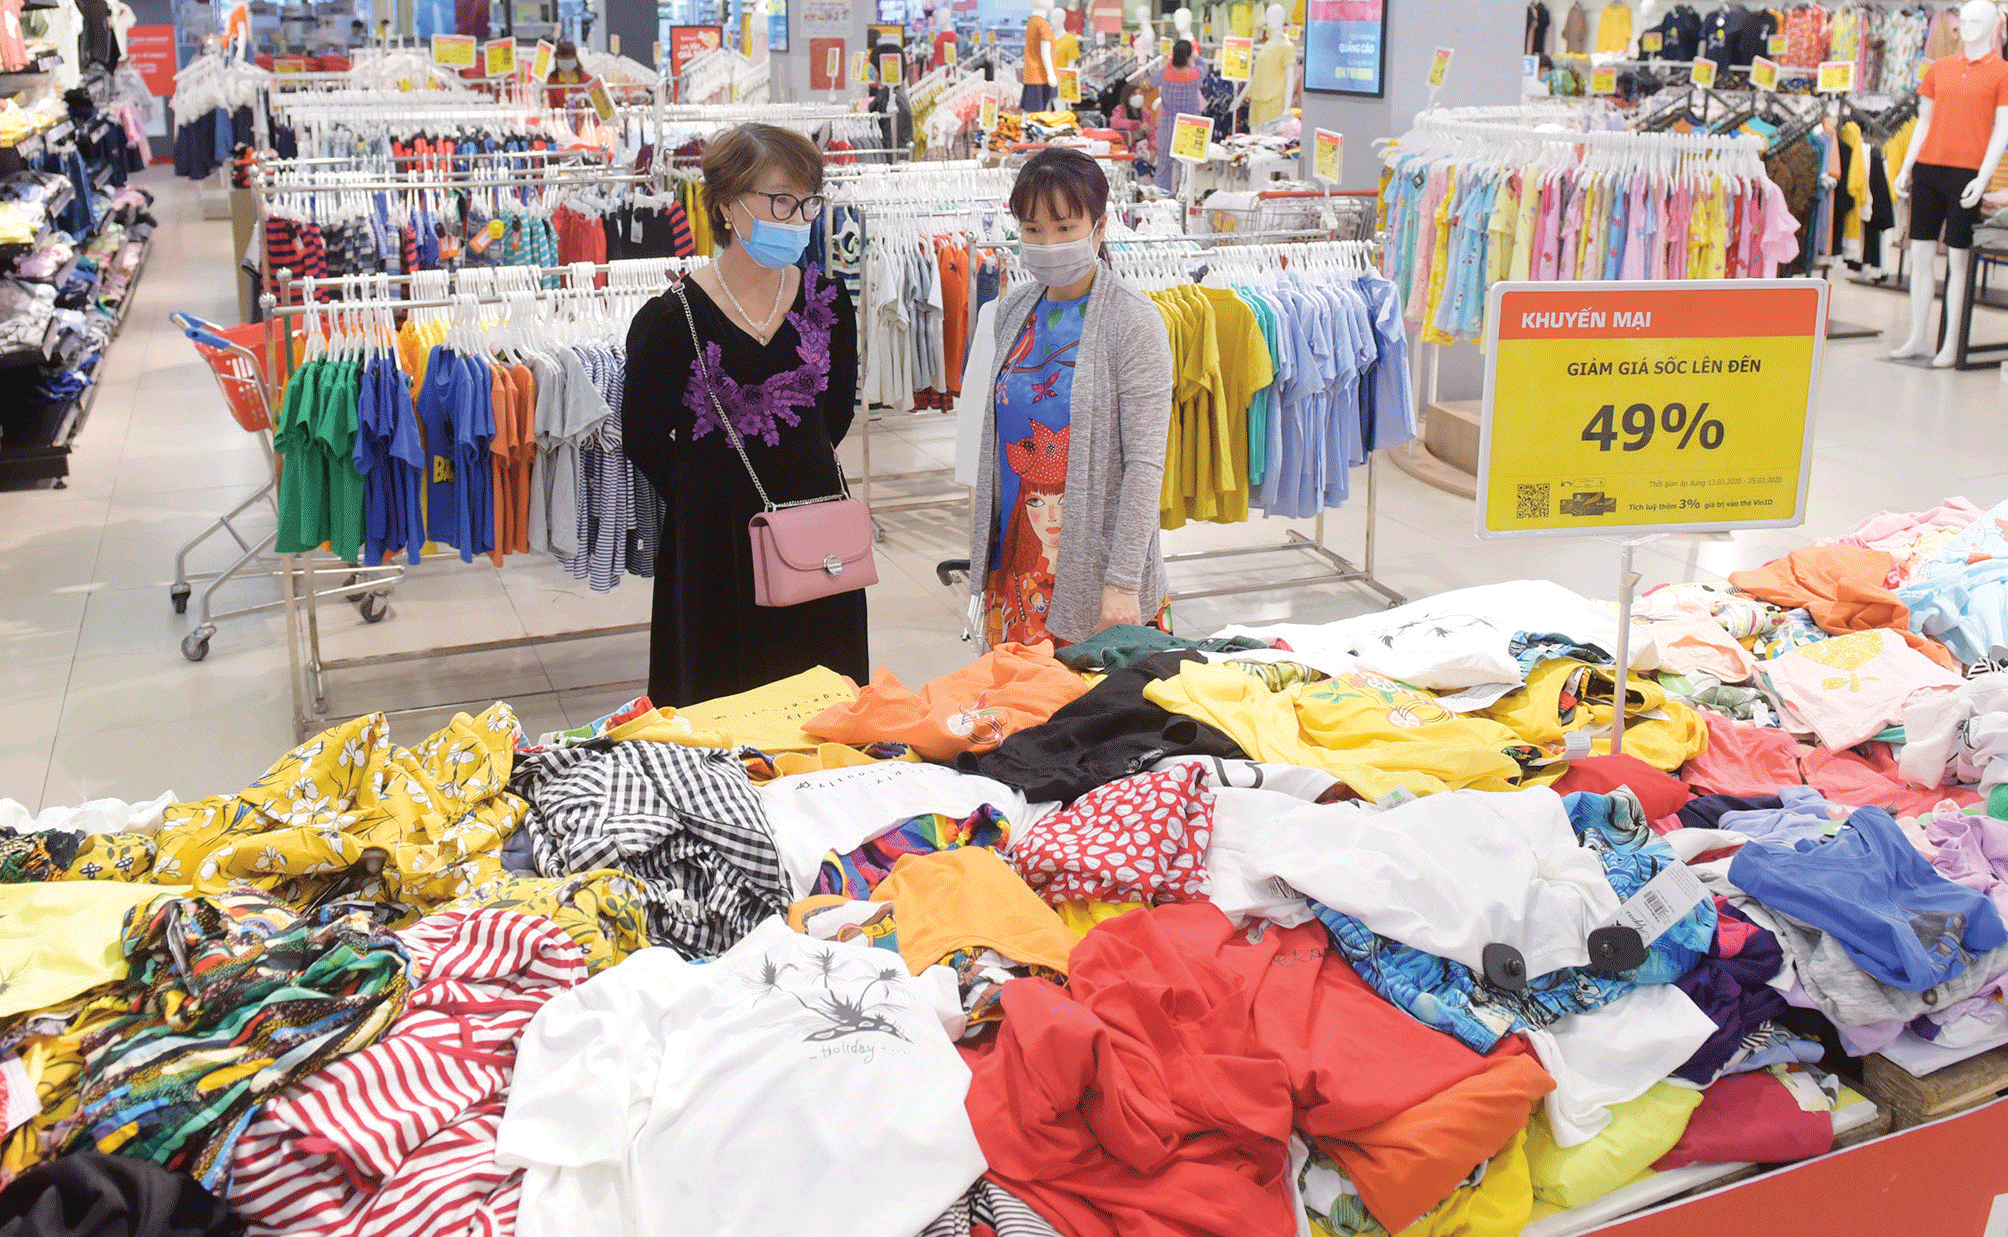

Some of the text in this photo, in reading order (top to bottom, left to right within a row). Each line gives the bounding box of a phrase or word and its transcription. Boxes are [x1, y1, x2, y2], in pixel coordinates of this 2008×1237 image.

[1521, 307, 1651, 330] KHUYẾN MẠI
[1567, 355, 1761, 376] GIẢM GIÁ SỐC LÊN ĐẾN
[1581, 402, 1725, 452] 49%
[1665, 481, 1678, 489] gian
[1629, 503, 1644, 511] Tích
[1658, 502, 1677, 510] thêm
[1679, 498, 1701, 509] 3%
[1704, 501, 1715, 510] giá
[1717, 500, 1725, 508] trị
[1740, 499, 1752, 507] thẻ
[1753, 498, 1774, 506] VinID
[822, 1038, 875, 1064] Holiday
